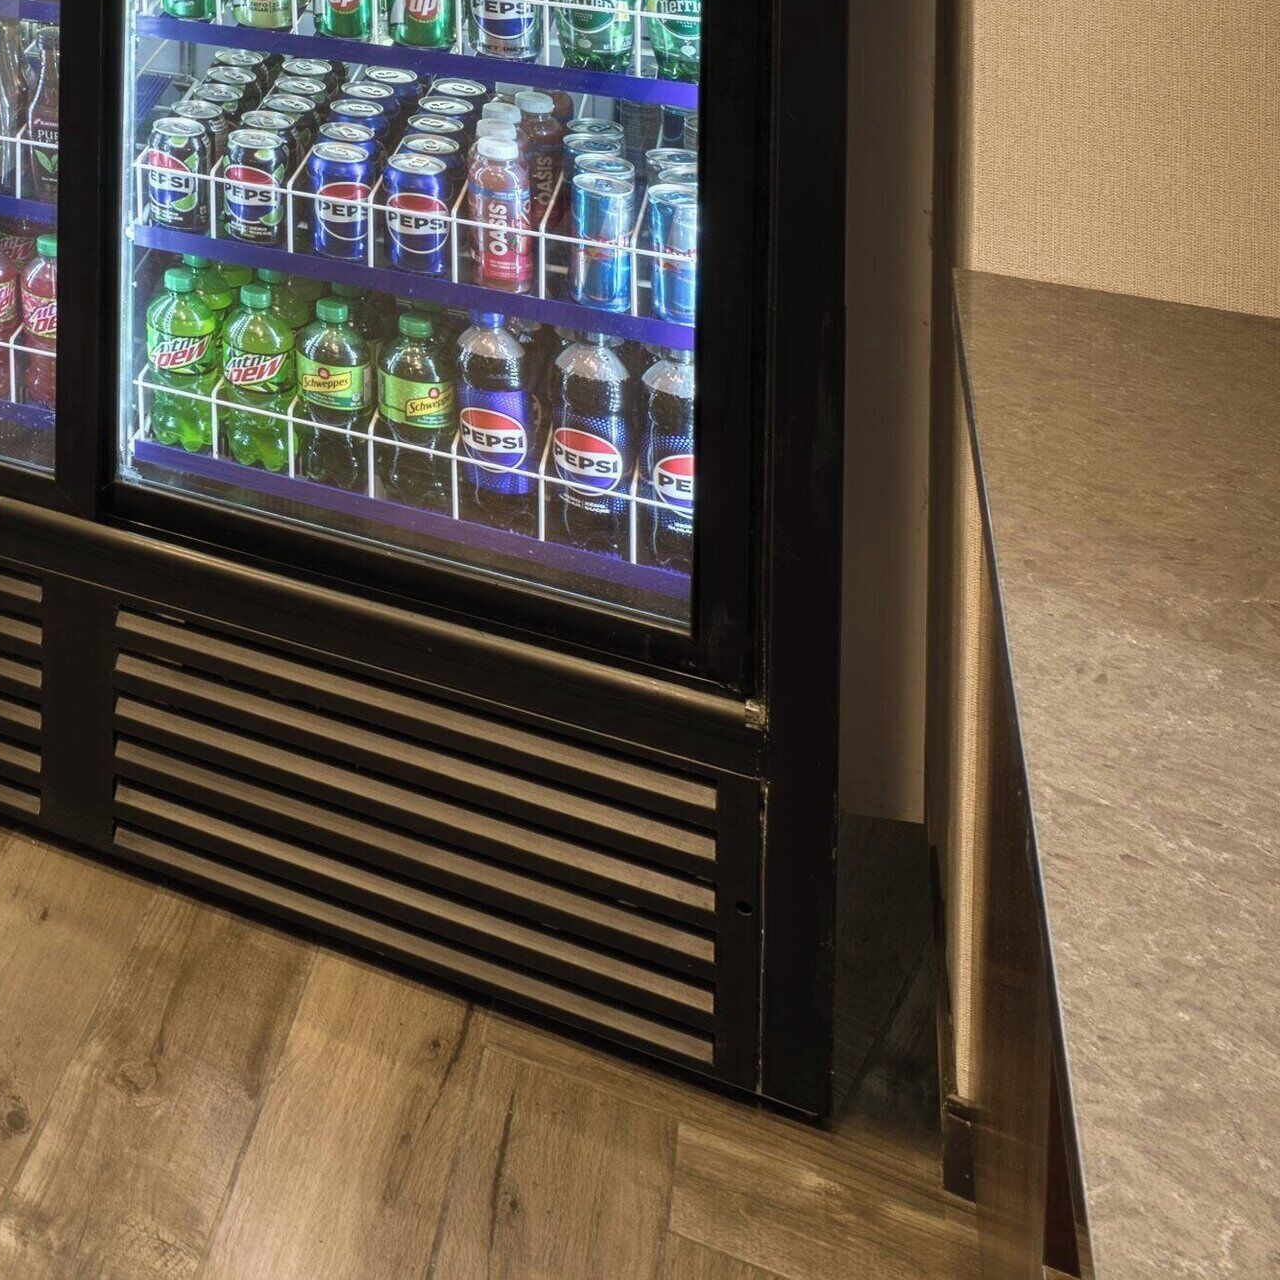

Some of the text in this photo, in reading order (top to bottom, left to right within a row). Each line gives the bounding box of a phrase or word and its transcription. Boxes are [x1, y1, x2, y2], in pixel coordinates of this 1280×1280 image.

[490, 204, 507, 256] OASIS
[304, 377, 348, 389] Schweppes
[463, 425, 523, 449] PEPSI
[555, 447, 619, 474] PEPSI
